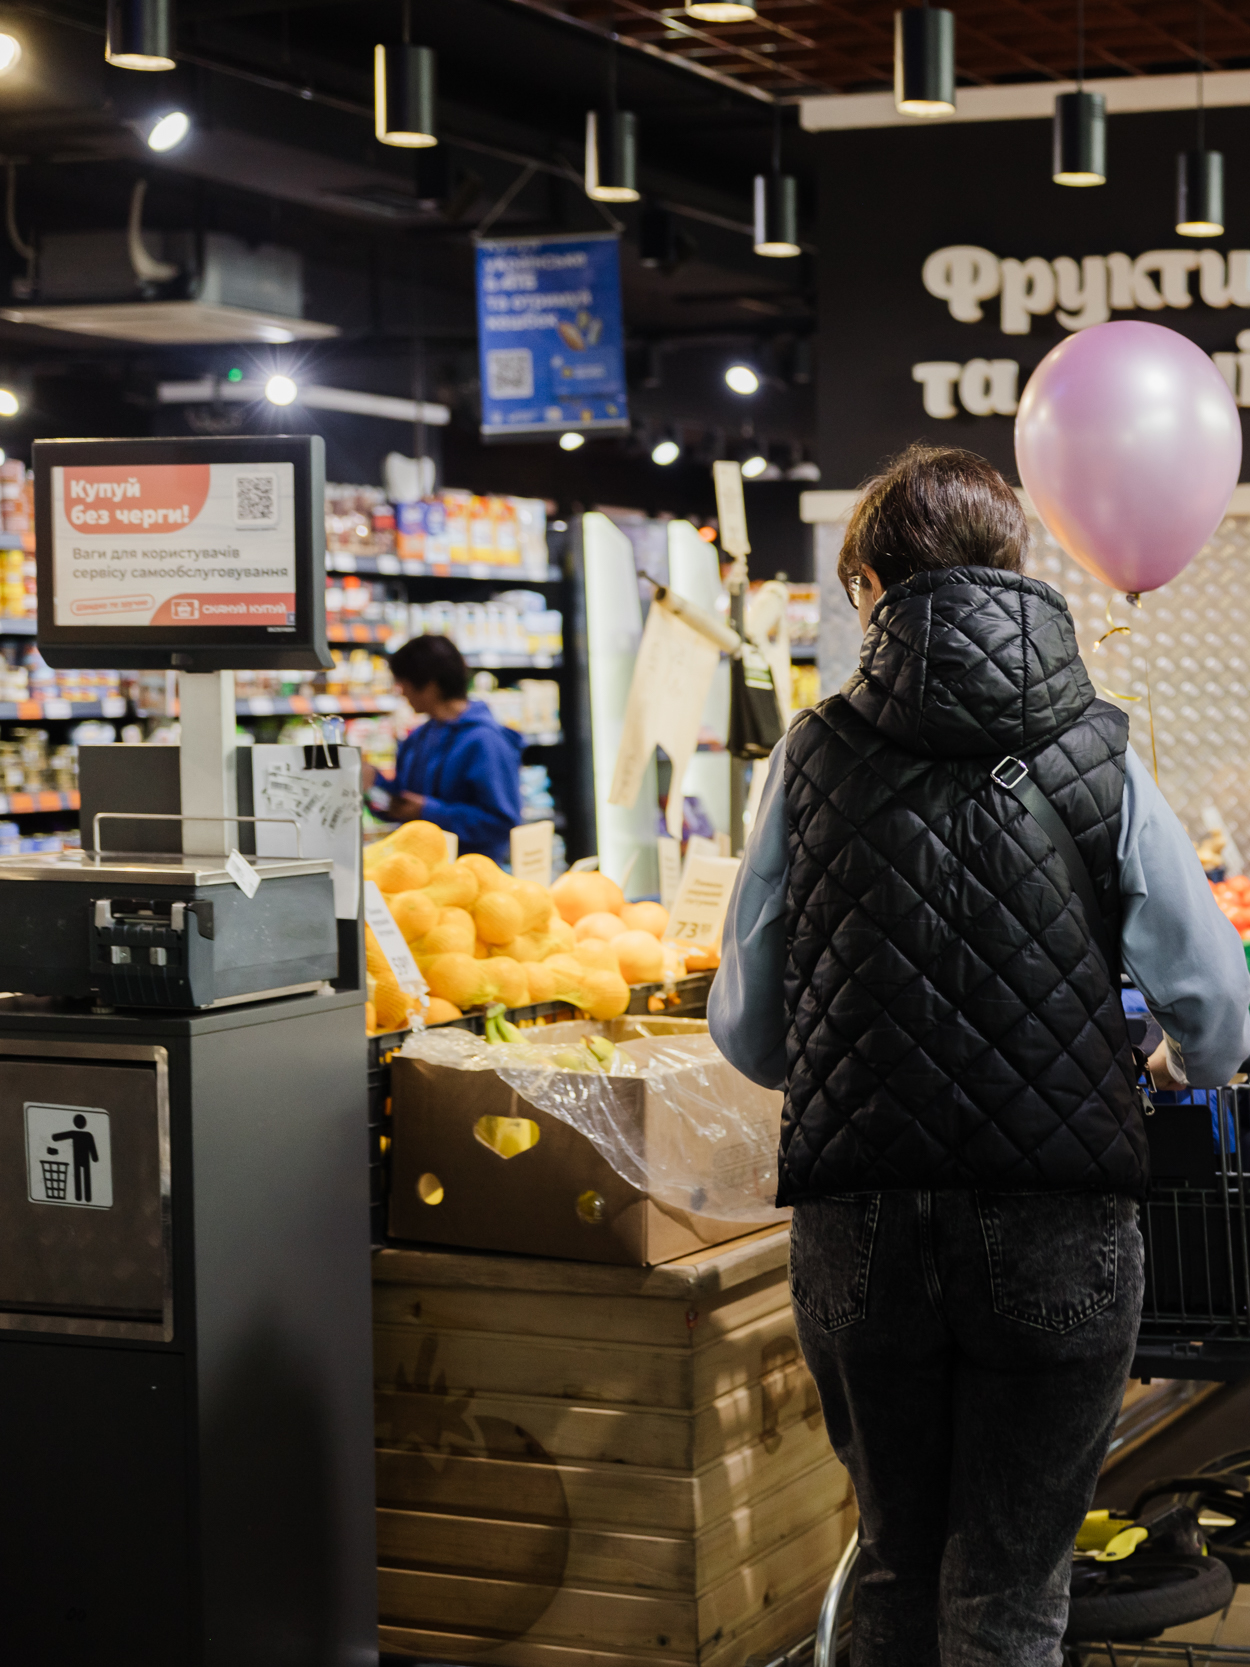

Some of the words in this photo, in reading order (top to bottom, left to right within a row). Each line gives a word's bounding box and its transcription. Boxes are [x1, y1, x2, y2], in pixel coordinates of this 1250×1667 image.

[912, 357, 1020, 420] та
[70, 477, 141, 503] Купуй
[70, 504, 110, 525] без
[115, 504, 190, 529] черги!
[72, 548, 107, 561] Ваги
[110, 549, 138, 561] для
[142, 545, 240, 562] користувачів
[73, 565, 127, 581] сервісу
[131, 565, 288, 581] самообслуговування
